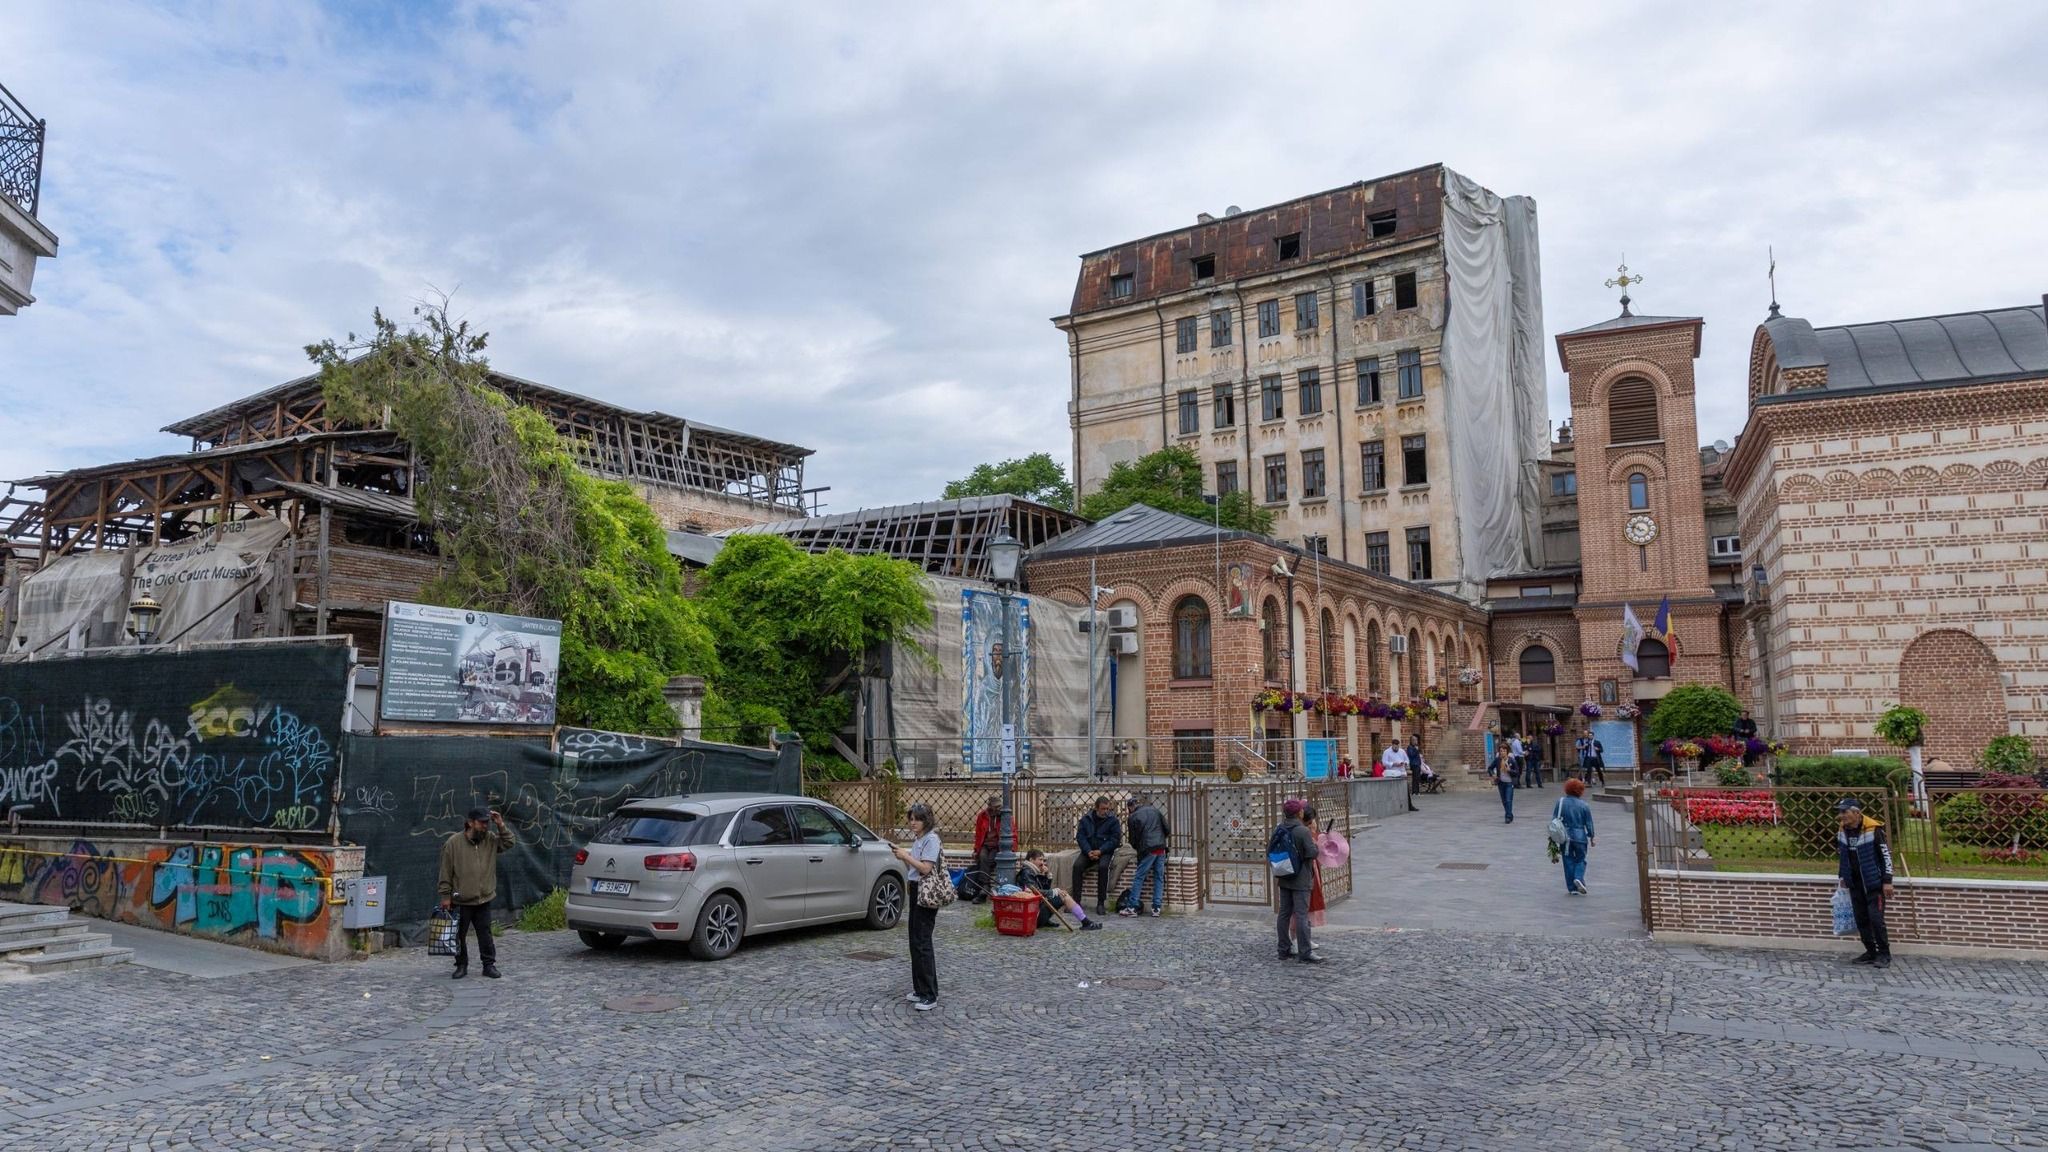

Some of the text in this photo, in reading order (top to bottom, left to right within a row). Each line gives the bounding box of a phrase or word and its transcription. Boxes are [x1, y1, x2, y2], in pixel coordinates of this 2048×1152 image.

[131, 576, 152, 590] The
[154, 571, 176, 587] Old
[177, 567, 209, 584] Court
